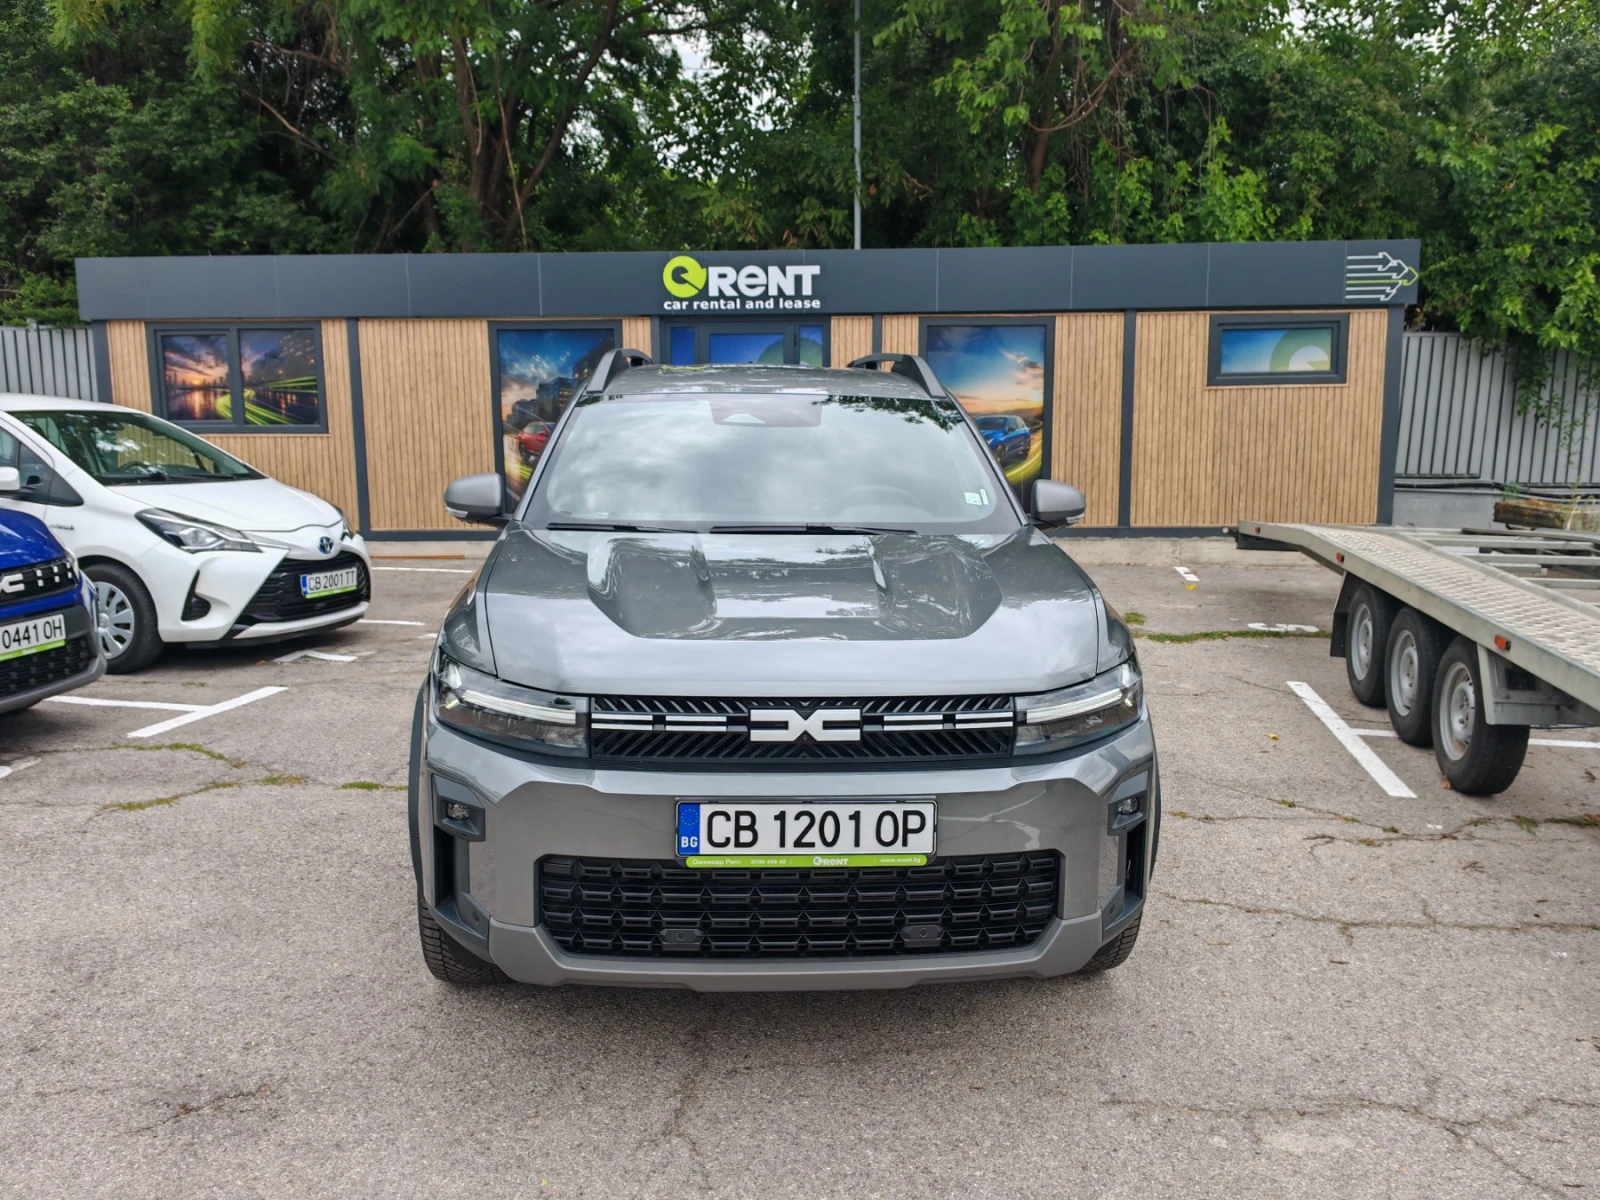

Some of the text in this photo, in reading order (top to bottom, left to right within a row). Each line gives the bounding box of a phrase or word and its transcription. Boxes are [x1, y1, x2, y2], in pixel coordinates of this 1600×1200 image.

[663, 297, 821, 310] car rental and lease
[308, 570, 355, 591] CB 2001 TT
[2, 618, 63, 649] 0441 OH
[706, 809, 926, 848] CB 1201 OP
[681, 836, 698, 848] BG
